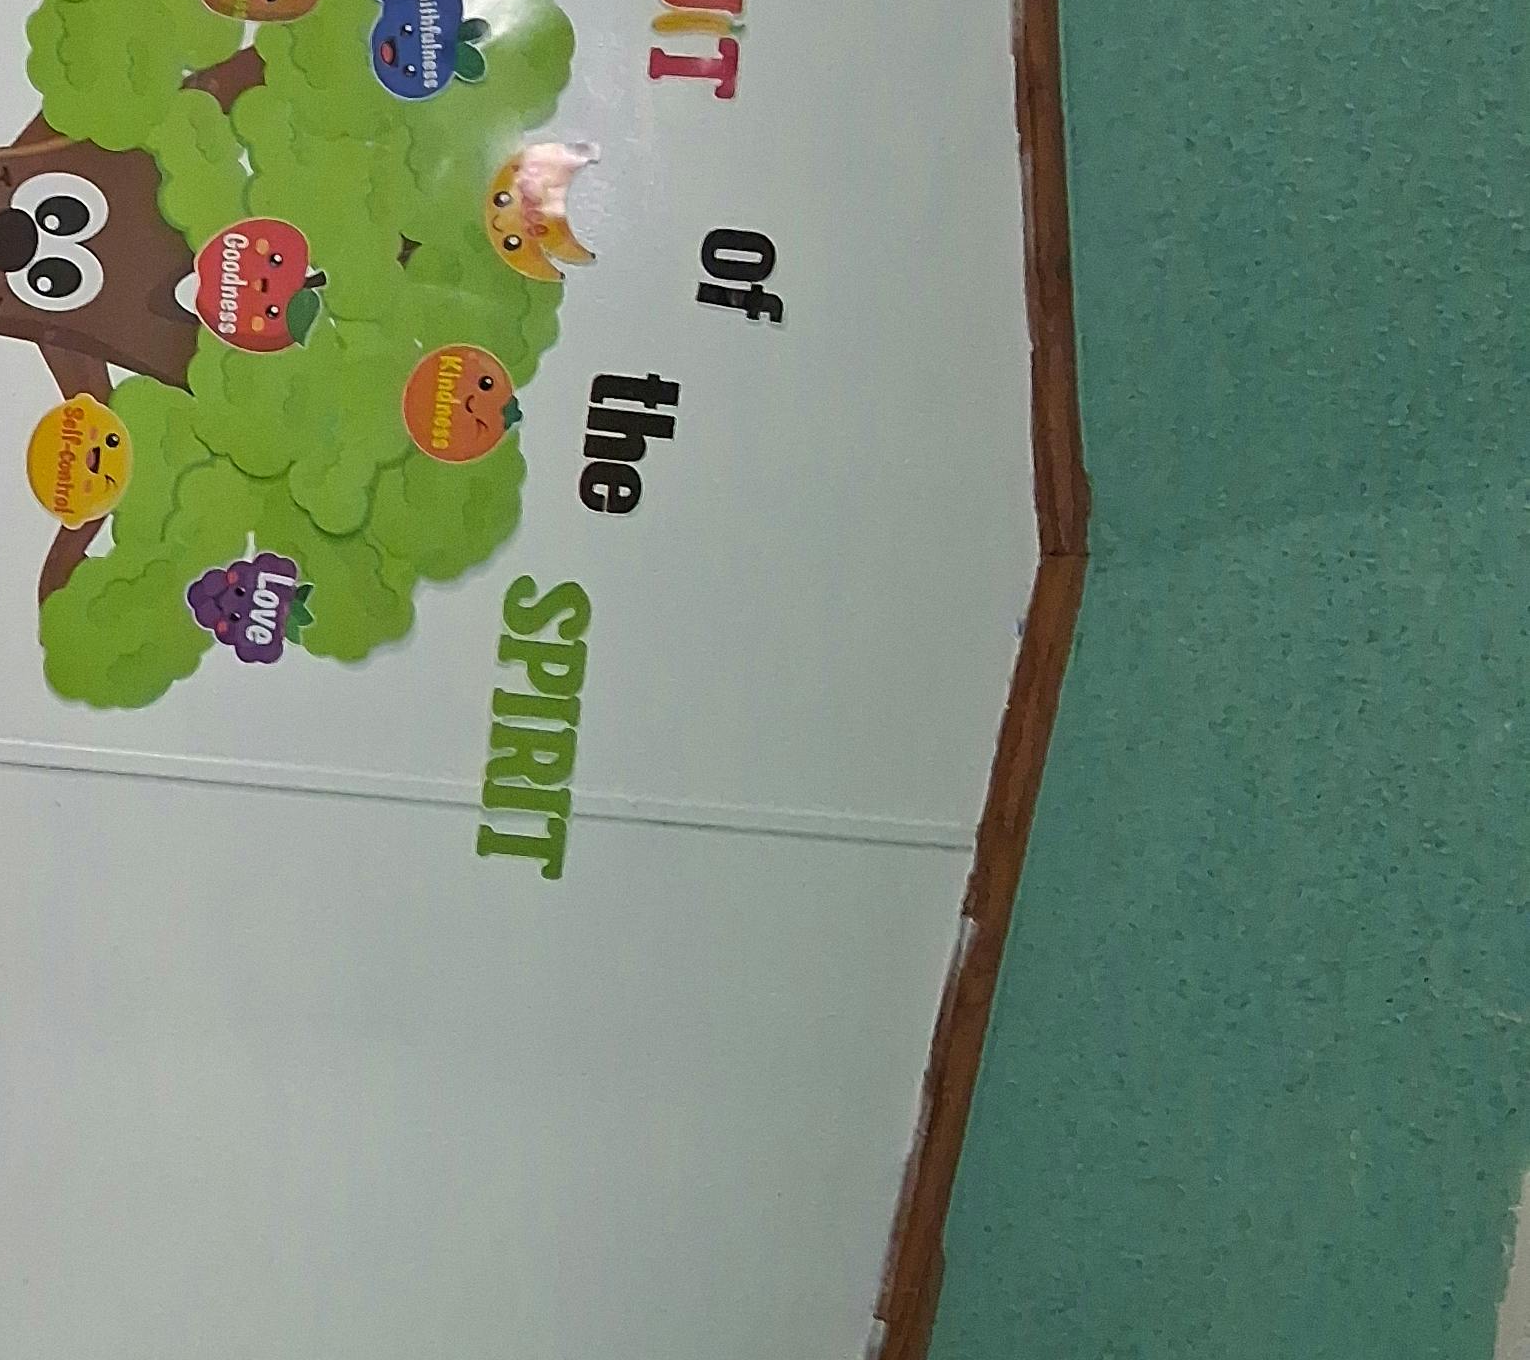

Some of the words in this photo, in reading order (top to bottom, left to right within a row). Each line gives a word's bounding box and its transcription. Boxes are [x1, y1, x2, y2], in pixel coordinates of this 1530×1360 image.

[217, 232, 250, 335] Goodness
[431, 355, 463, 450] Kindness
[579, 373, 680, 515] the
[245, 571, 295, 645] Love
[477, 574, 592, 881] SPIRIT
